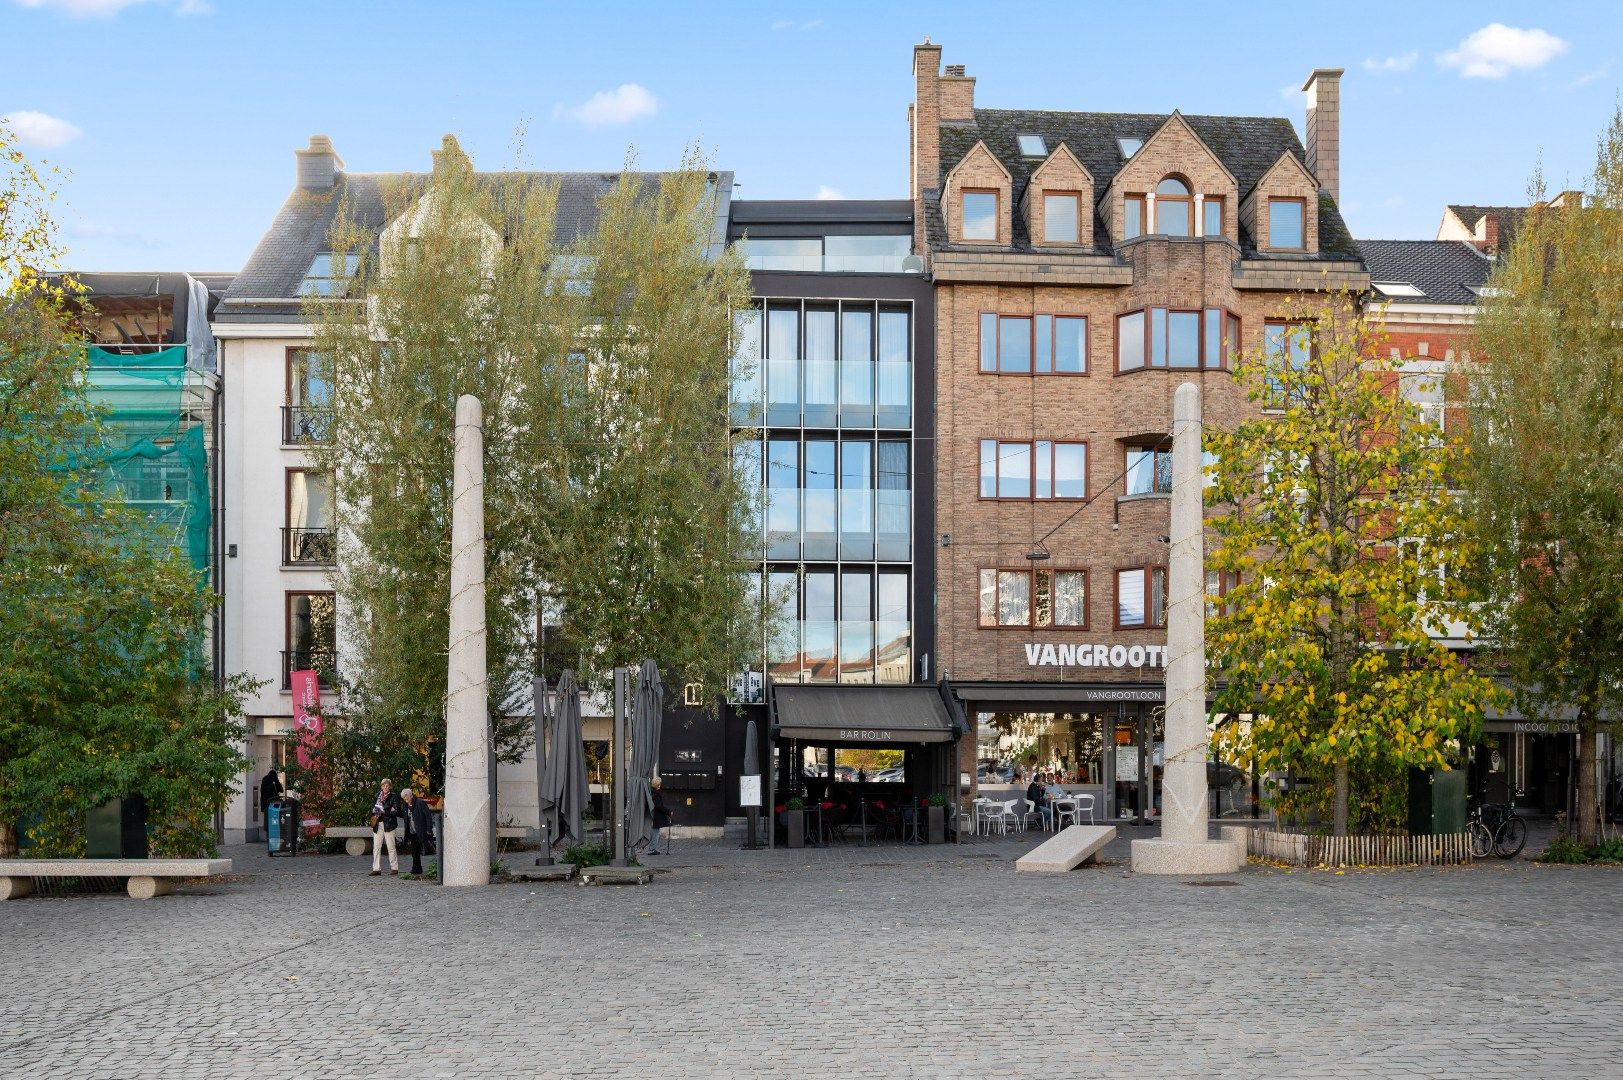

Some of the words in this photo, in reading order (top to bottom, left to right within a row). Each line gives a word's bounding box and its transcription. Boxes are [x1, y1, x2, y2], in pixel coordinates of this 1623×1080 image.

[1024, 643, 1223, 668] VANGROOT
[1086, 691, 1161, 700] VANGROOTLOON
[1514, 722, 1570, 732] INCOGTO
[840, 730, 859, 739] BAR
[861, 730, 891, 740] ROLIN
